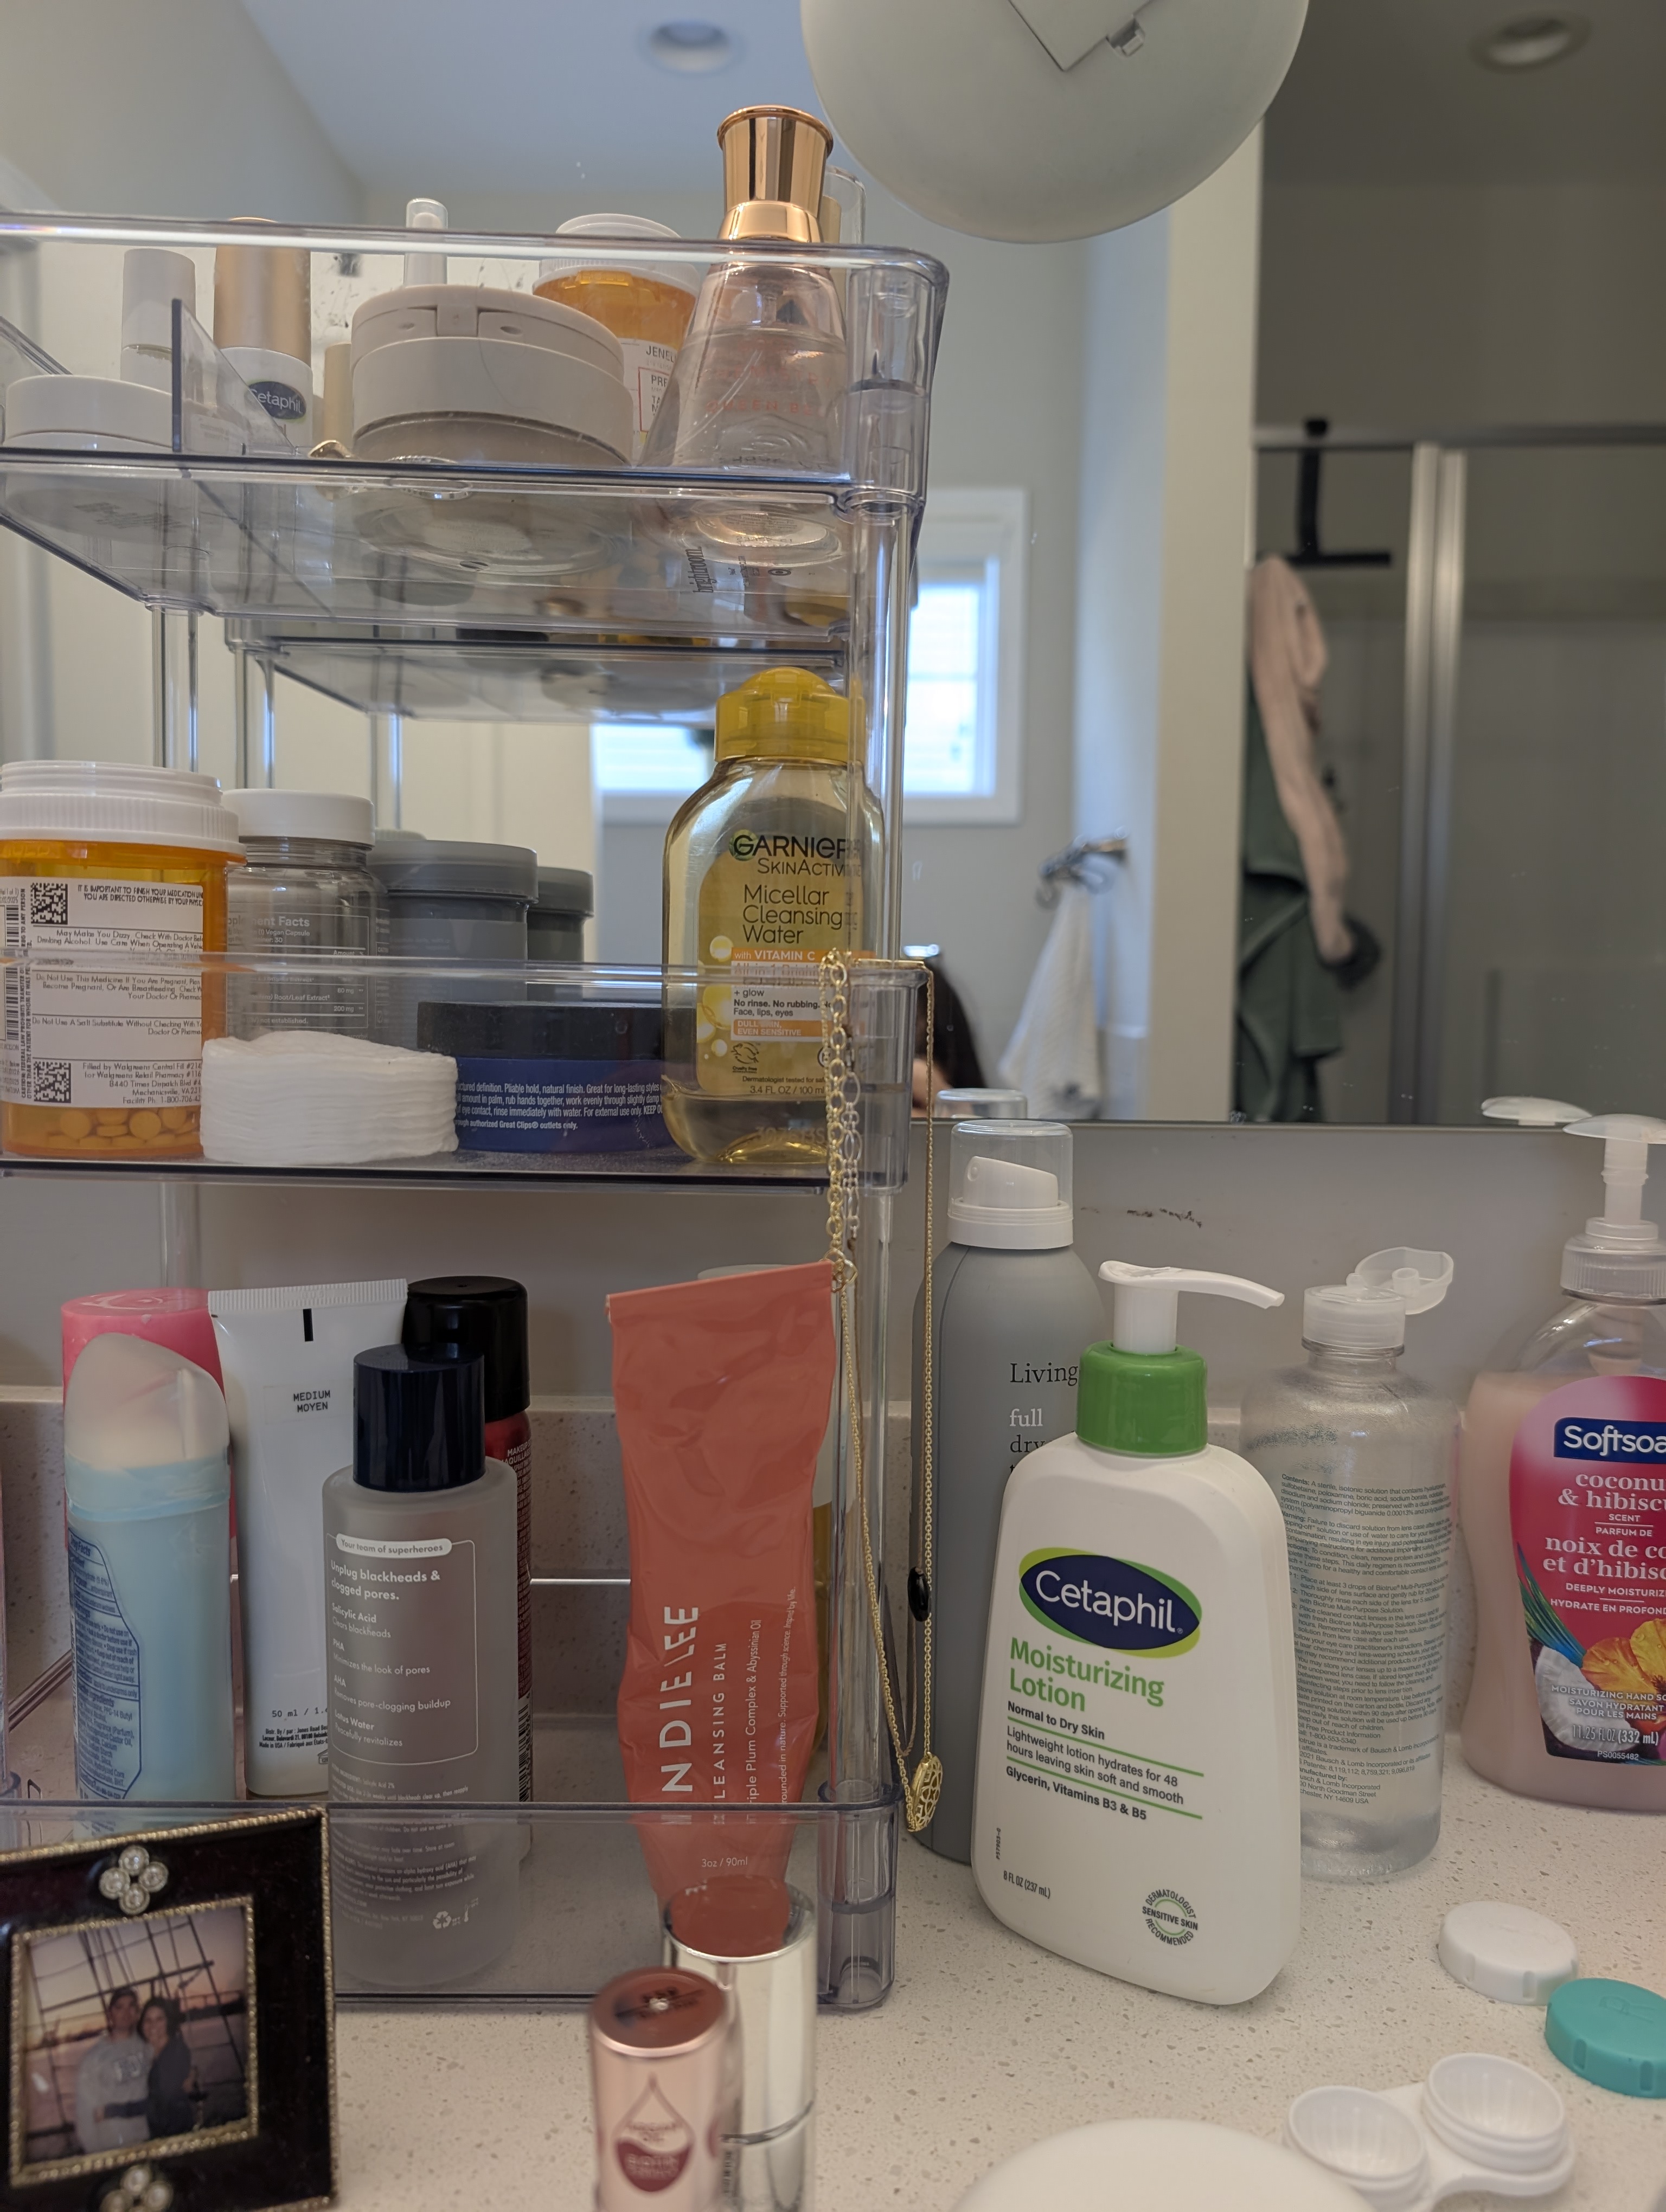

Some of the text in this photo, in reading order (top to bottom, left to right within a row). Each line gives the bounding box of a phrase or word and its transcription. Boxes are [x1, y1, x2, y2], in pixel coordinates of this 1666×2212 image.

[685, 546, 717, 593] brightroom
[744, 884, 829, 905] Micellar
[279, 916, 310, 927] Facts
[743, 904, 842, 930] Cleansing
[742, 924, 804, 944] Water
[735, 950, 815, 961] with VITAMIN C
[743, 989, 764, 998] glow
[734, 1008, 793, 1018] Face, lips, eyes
[787, 1000, 820, 1009] rubbing.
[104, 1063, 111, 1072] by
[114, 1063, 150, 1072] Walgreens
[152, 1080, 178, 1088] Dispatch
[477, 1083, 645, 1095] definition. Pliable hold, natural finish. Great for long-lasting
[750, 1085, 762, 1094] 3.4
[778, 1086, 791, 1094] OZ
[800, 1086, 813, 1094] 100
[815, 1086, 824, 1094] ml
[470, 1120, 498, 1128] authorized
[563, 1121, 578, 1130] only.
[1009, 1361, 1079, 1387] Living
[293, 1390, 331, 1403] MEDIUM
[297, 1401, 329, 1413] MOYEN
[1009, 1408, 1043, 1427] full
[1281, 1474, 1309, 1485] Contents:
[1338, 1485, 1362, 1493] isotonic
[1575, 1474, 1665, 1491] coconu
[1558, 1488, 1579, 1506] &
[1609, 1513, 1641, 1522] SCENT
[1595, 1526, 1652, 1537] PARFUM DE
[388, 1543, 444, 1555] superheroes
[1546, 1536, 1638, 1558] noix de
[330, 1559, 440, 1583] Unplug blackheads &
[1543, 1556, 1566, 1573] et
[331, 1579, 400, 1601] clogged pores.
[1566, 1583, 1605, 1594] DEEPLY
[1035, 1569, 1176, 1634] Cetaphil
[1550, 1598, 1600, 1612] HYDRATE
[1602, 1604, 1617, 1613] EN
[779, 1653, 790, 1676] through
[1010, 1637, 1165, 1708] Moisturizing
[778, 1678, 788, 1718] Supported
[1009, 1667, 1086, 1712] Lotion
[1551, 1684, 1654, 1701] MOISTURIZING HAND
[358, 1697, 451, 1713] pore-clogging buildup
[745, 1631, 761, 1771] Plum Complex Abyssinian
[1569, 1698, 1664, 1712] SAVON HYDRATANT
[713, 1643, 727, 1800] LEANSING BALM
[1008, 1700, 1105, 1740] Normal to Dry Skin
[1577, 1707, 1657, 1720] POUR LES MAINS
[659, 1671, 693, 1792] NDIE
[1321, 1727, 1345, 1736] Product
[1007, 1725, 1178, 1787] Lightweight lotion hydrates for 48
[1316, 1755, 1339, 1765] Bausch
[1366, 1760, 1402, 1769] Incorporated
[1597, 1750, 1639, 1760] PS0055482
[1007, 1740, 1184, 1805] hours leaving skin soft and smooth
[1006, 1765, 1146, 1820] Glycerin, Vitamins B3 & B5
[1308, 1783, 1325, 1792] North
[1327, 1787, 1356, 1797] Goodman
[701, 1856, 748, 1868] 3oz 90ml
[1003, 1870, 1050, 1899] 8 FL OZ (237 mL)
[1145, 1889, 1196, 1918] DERMATOLOGIST
[1142, 1906, 1198, 1930] SENSITIVE SKIN
[1145, 1918, 1193, 1945] RECOMMENDED
